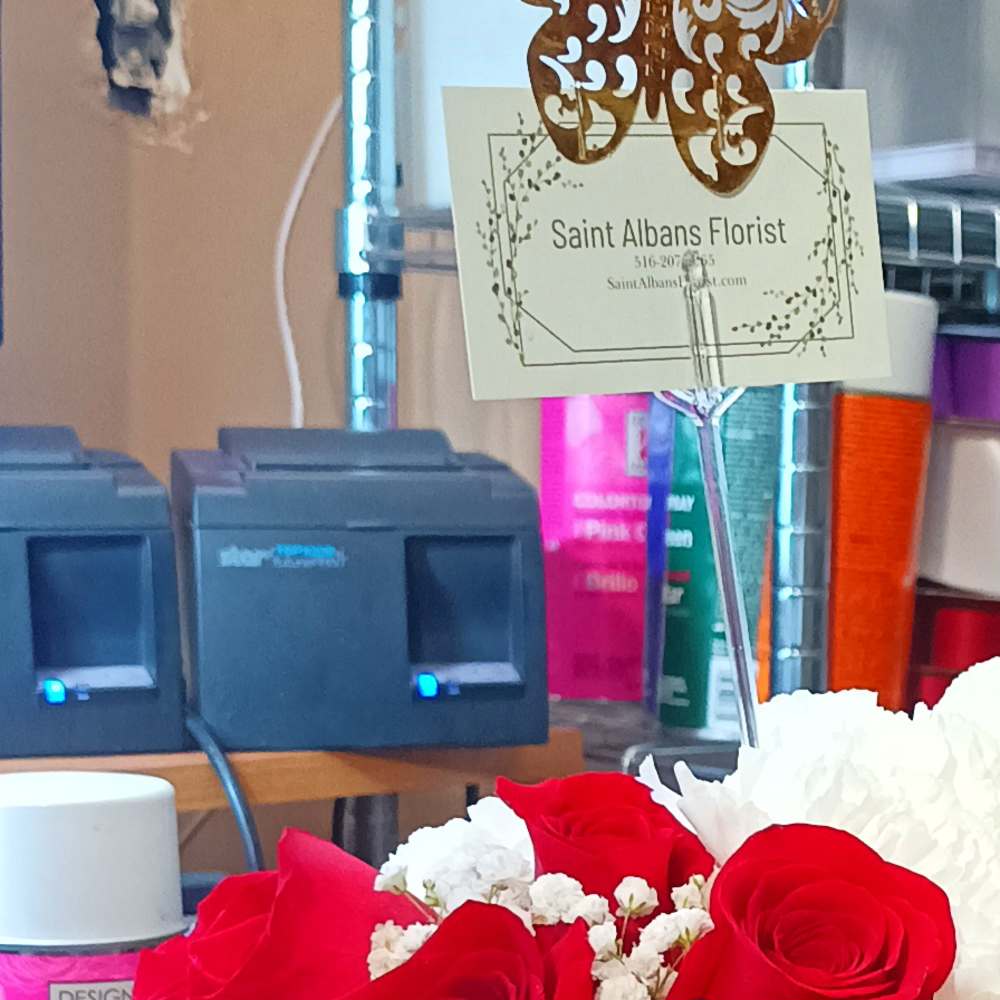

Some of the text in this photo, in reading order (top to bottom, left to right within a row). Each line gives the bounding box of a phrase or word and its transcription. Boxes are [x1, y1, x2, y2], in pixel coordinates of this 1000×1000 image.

[551, 215, 787, 249] Saint Albans Florist
